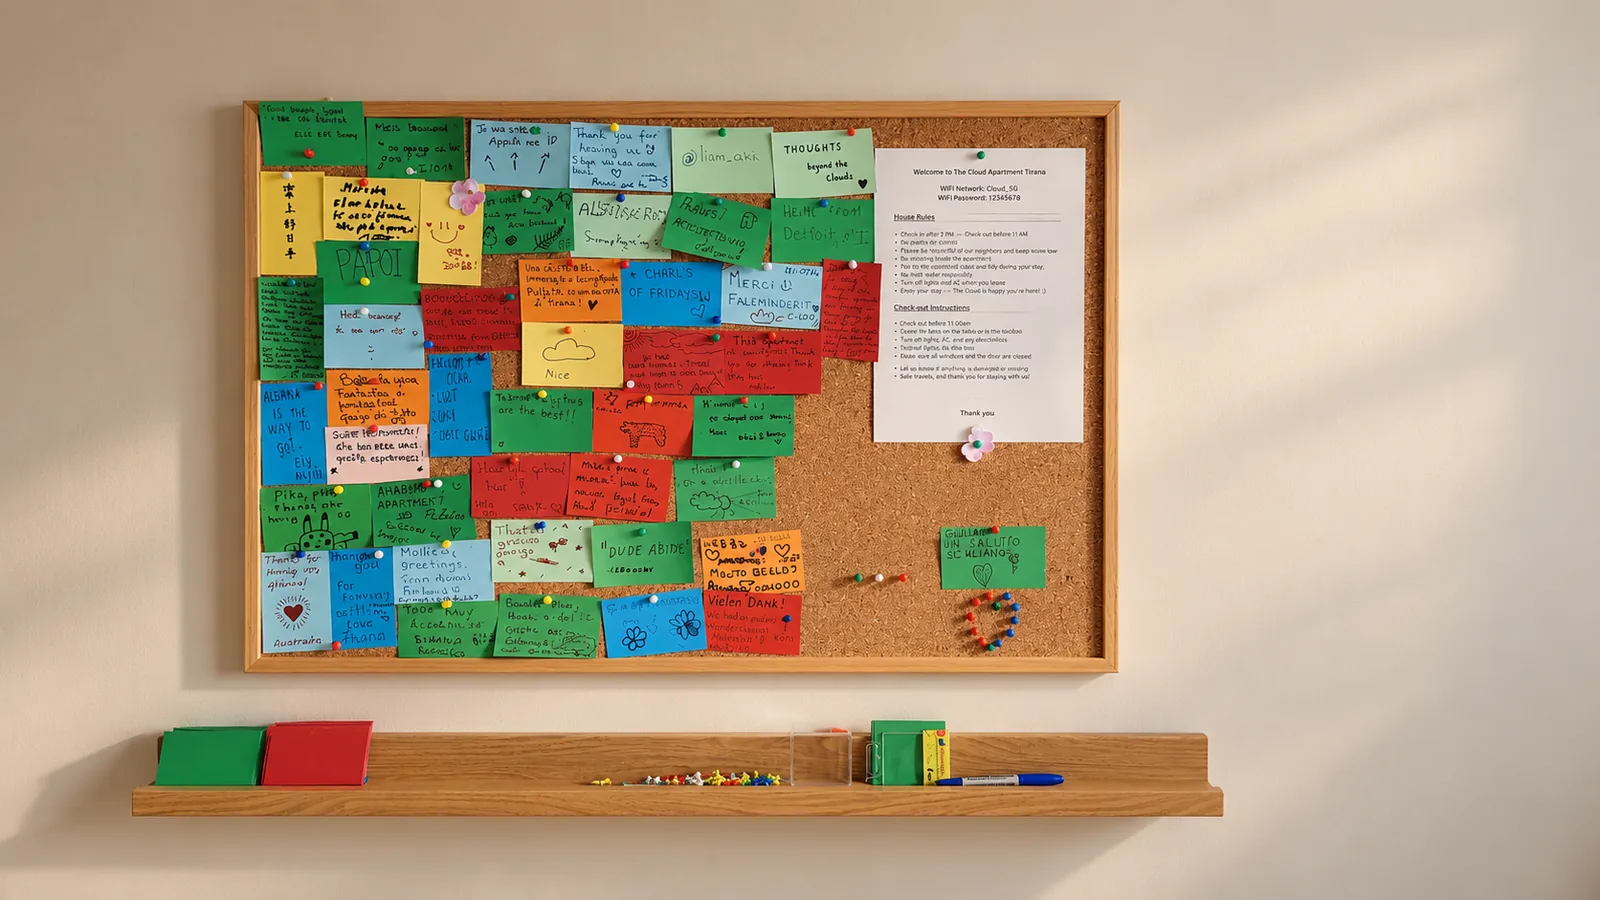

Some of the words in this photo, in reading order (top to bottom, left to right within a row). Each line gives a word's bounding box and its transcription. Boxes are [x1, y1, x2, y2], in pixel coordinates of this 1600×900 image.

[783, 142, 842, 154] THOUGHTS
[806, 162, 833, 174] beyond
[835, 160, 848, 168] the
[826, 173, 854, 182] Clouds
[988, 169, 1024, 177] Apartment
[645, 267, 693, 278] CHARL'S
[629, 288, 642, 297] OF
[545, 369, 570, 380] Nice
[273, 408, 282, 419] IS
[519, 405, 535, 416] the
[268, 423, 292, 435] WAY
[299, 421, 311, 431] TO
[708, 595, 742, 608] Vielen
